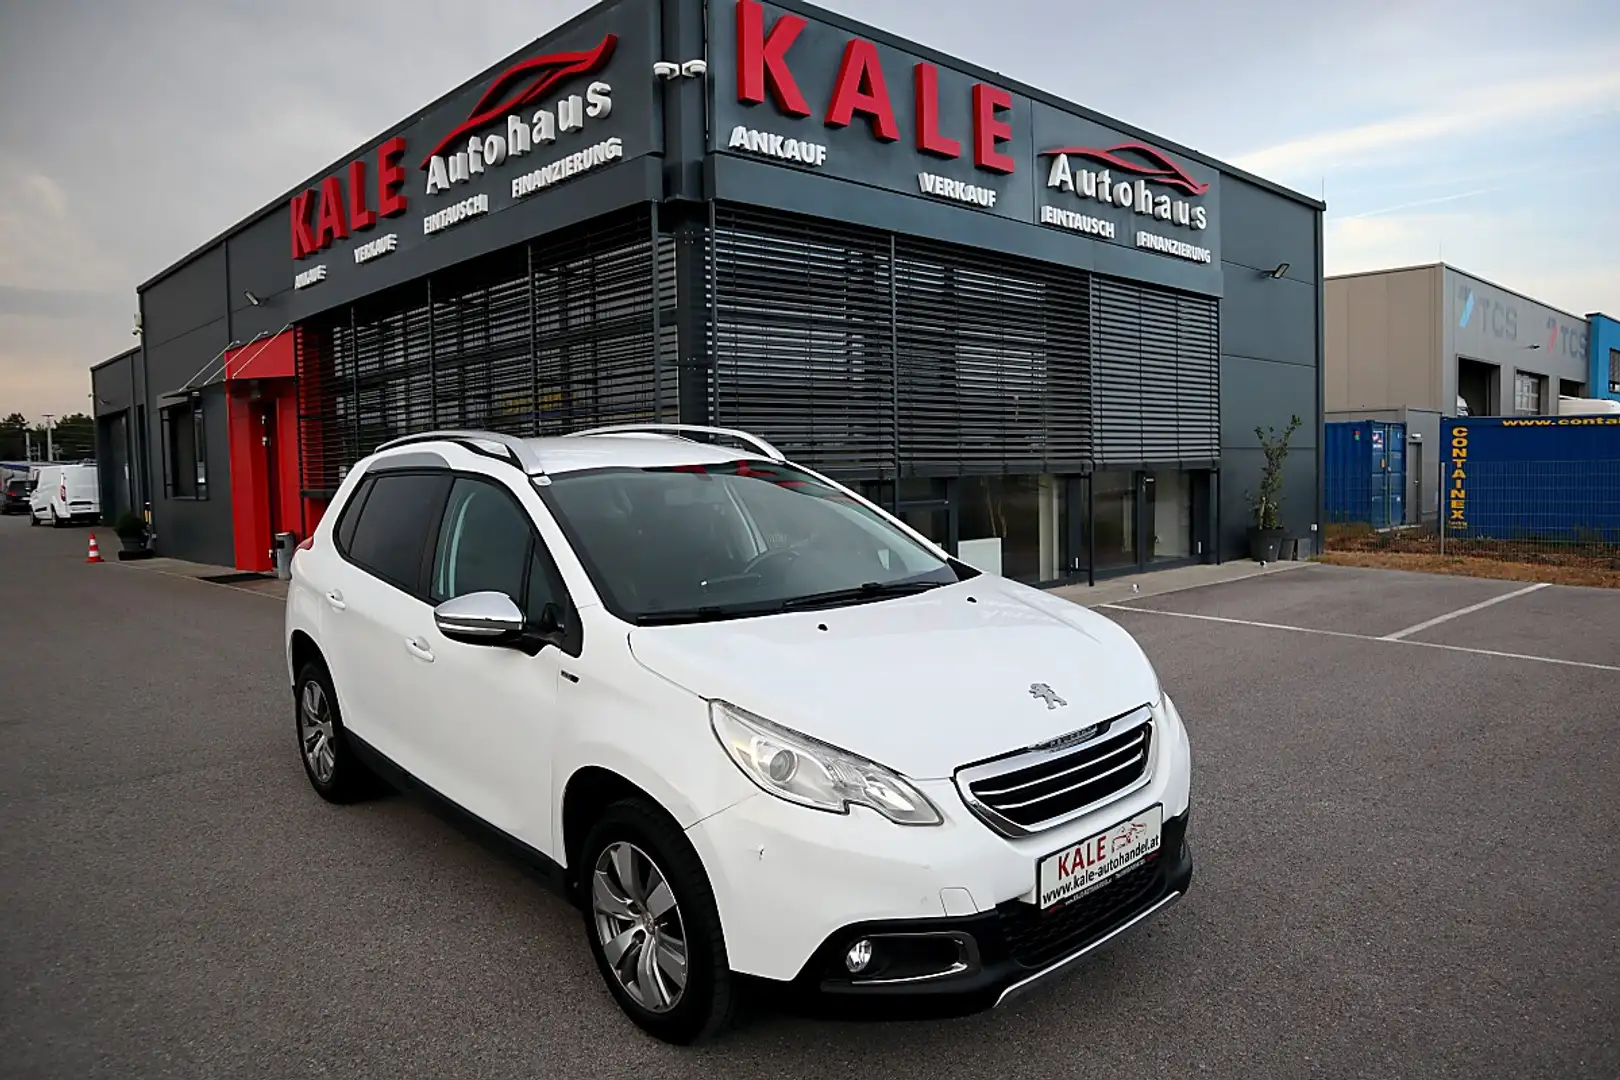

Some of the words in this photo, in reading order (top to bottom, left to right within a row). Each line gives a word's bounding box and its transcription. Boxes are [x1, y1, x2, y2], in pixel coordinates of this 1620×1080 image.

[737, 0, 1015, 173] KALE
[1047, 153, 1207, 230] Autohaus
[291, 137, 408, 260] KALE
[426, 81, 612, 195] Autohaus
[423, 193, 489, 235] EINTAUSCH
[511, 136, 623, 199] FINANZIERUNG
[728, 125, 827, 166] ANKAUF
[917, 171, 997, 208] VERKAUF
[1040, 205, 1115, 239] EINTAUSCH
[1136, 230, 1211, 264] FINANZIERUNG
[1479, 297, 1518, 341] TCS
[1502, 417, 1620, 427] www.conta
[1450, 427, 1469, 519] CONTAINEX
[1042, 834, 1160, 903] www.kale-autohandel.at
[1057, 835, 1107, 881] KALE
